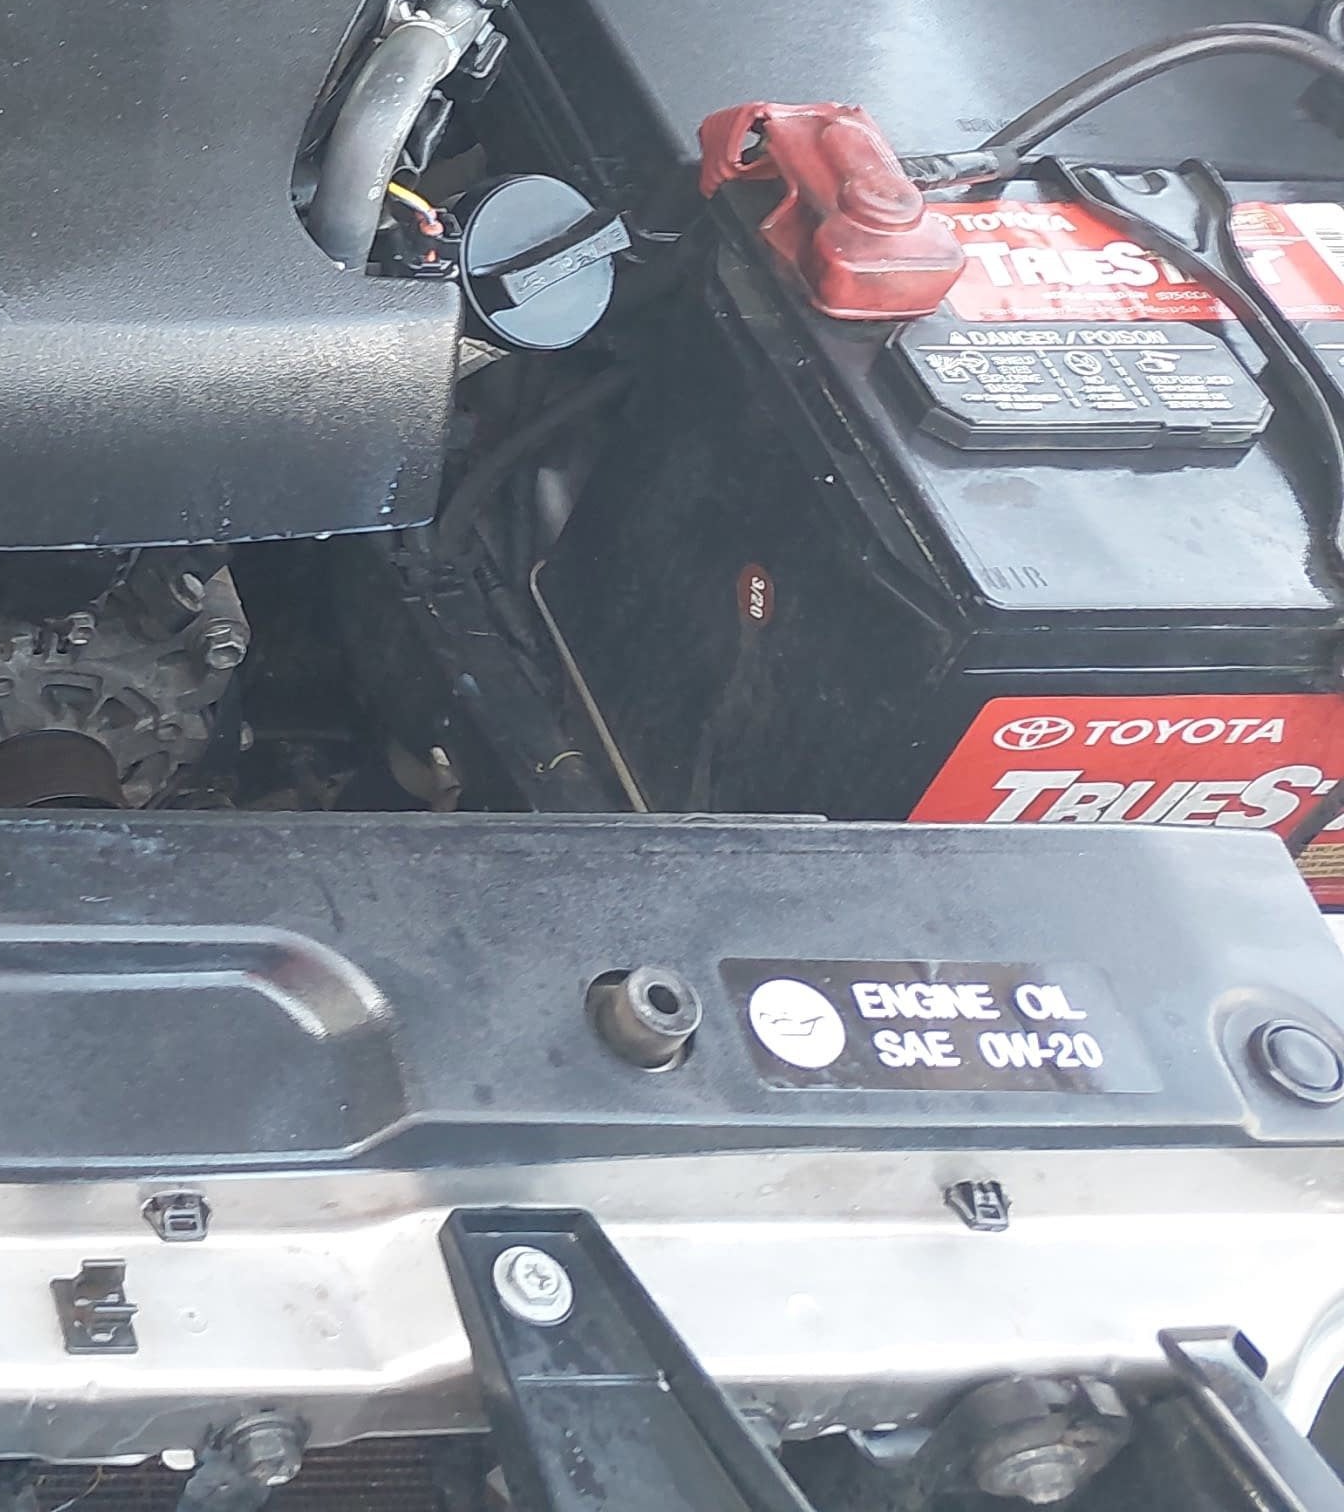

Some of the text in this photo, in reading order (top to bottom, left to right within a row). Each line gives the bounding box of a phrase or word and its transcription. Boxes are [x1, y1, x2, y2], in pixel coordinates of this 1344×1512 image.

[1083, 718, 1286, 745] TOYOTA
[852, 982, 1088, 1020] ENGINE OIL
[873, 1029, 1105, 1069] SAE 0W-20
